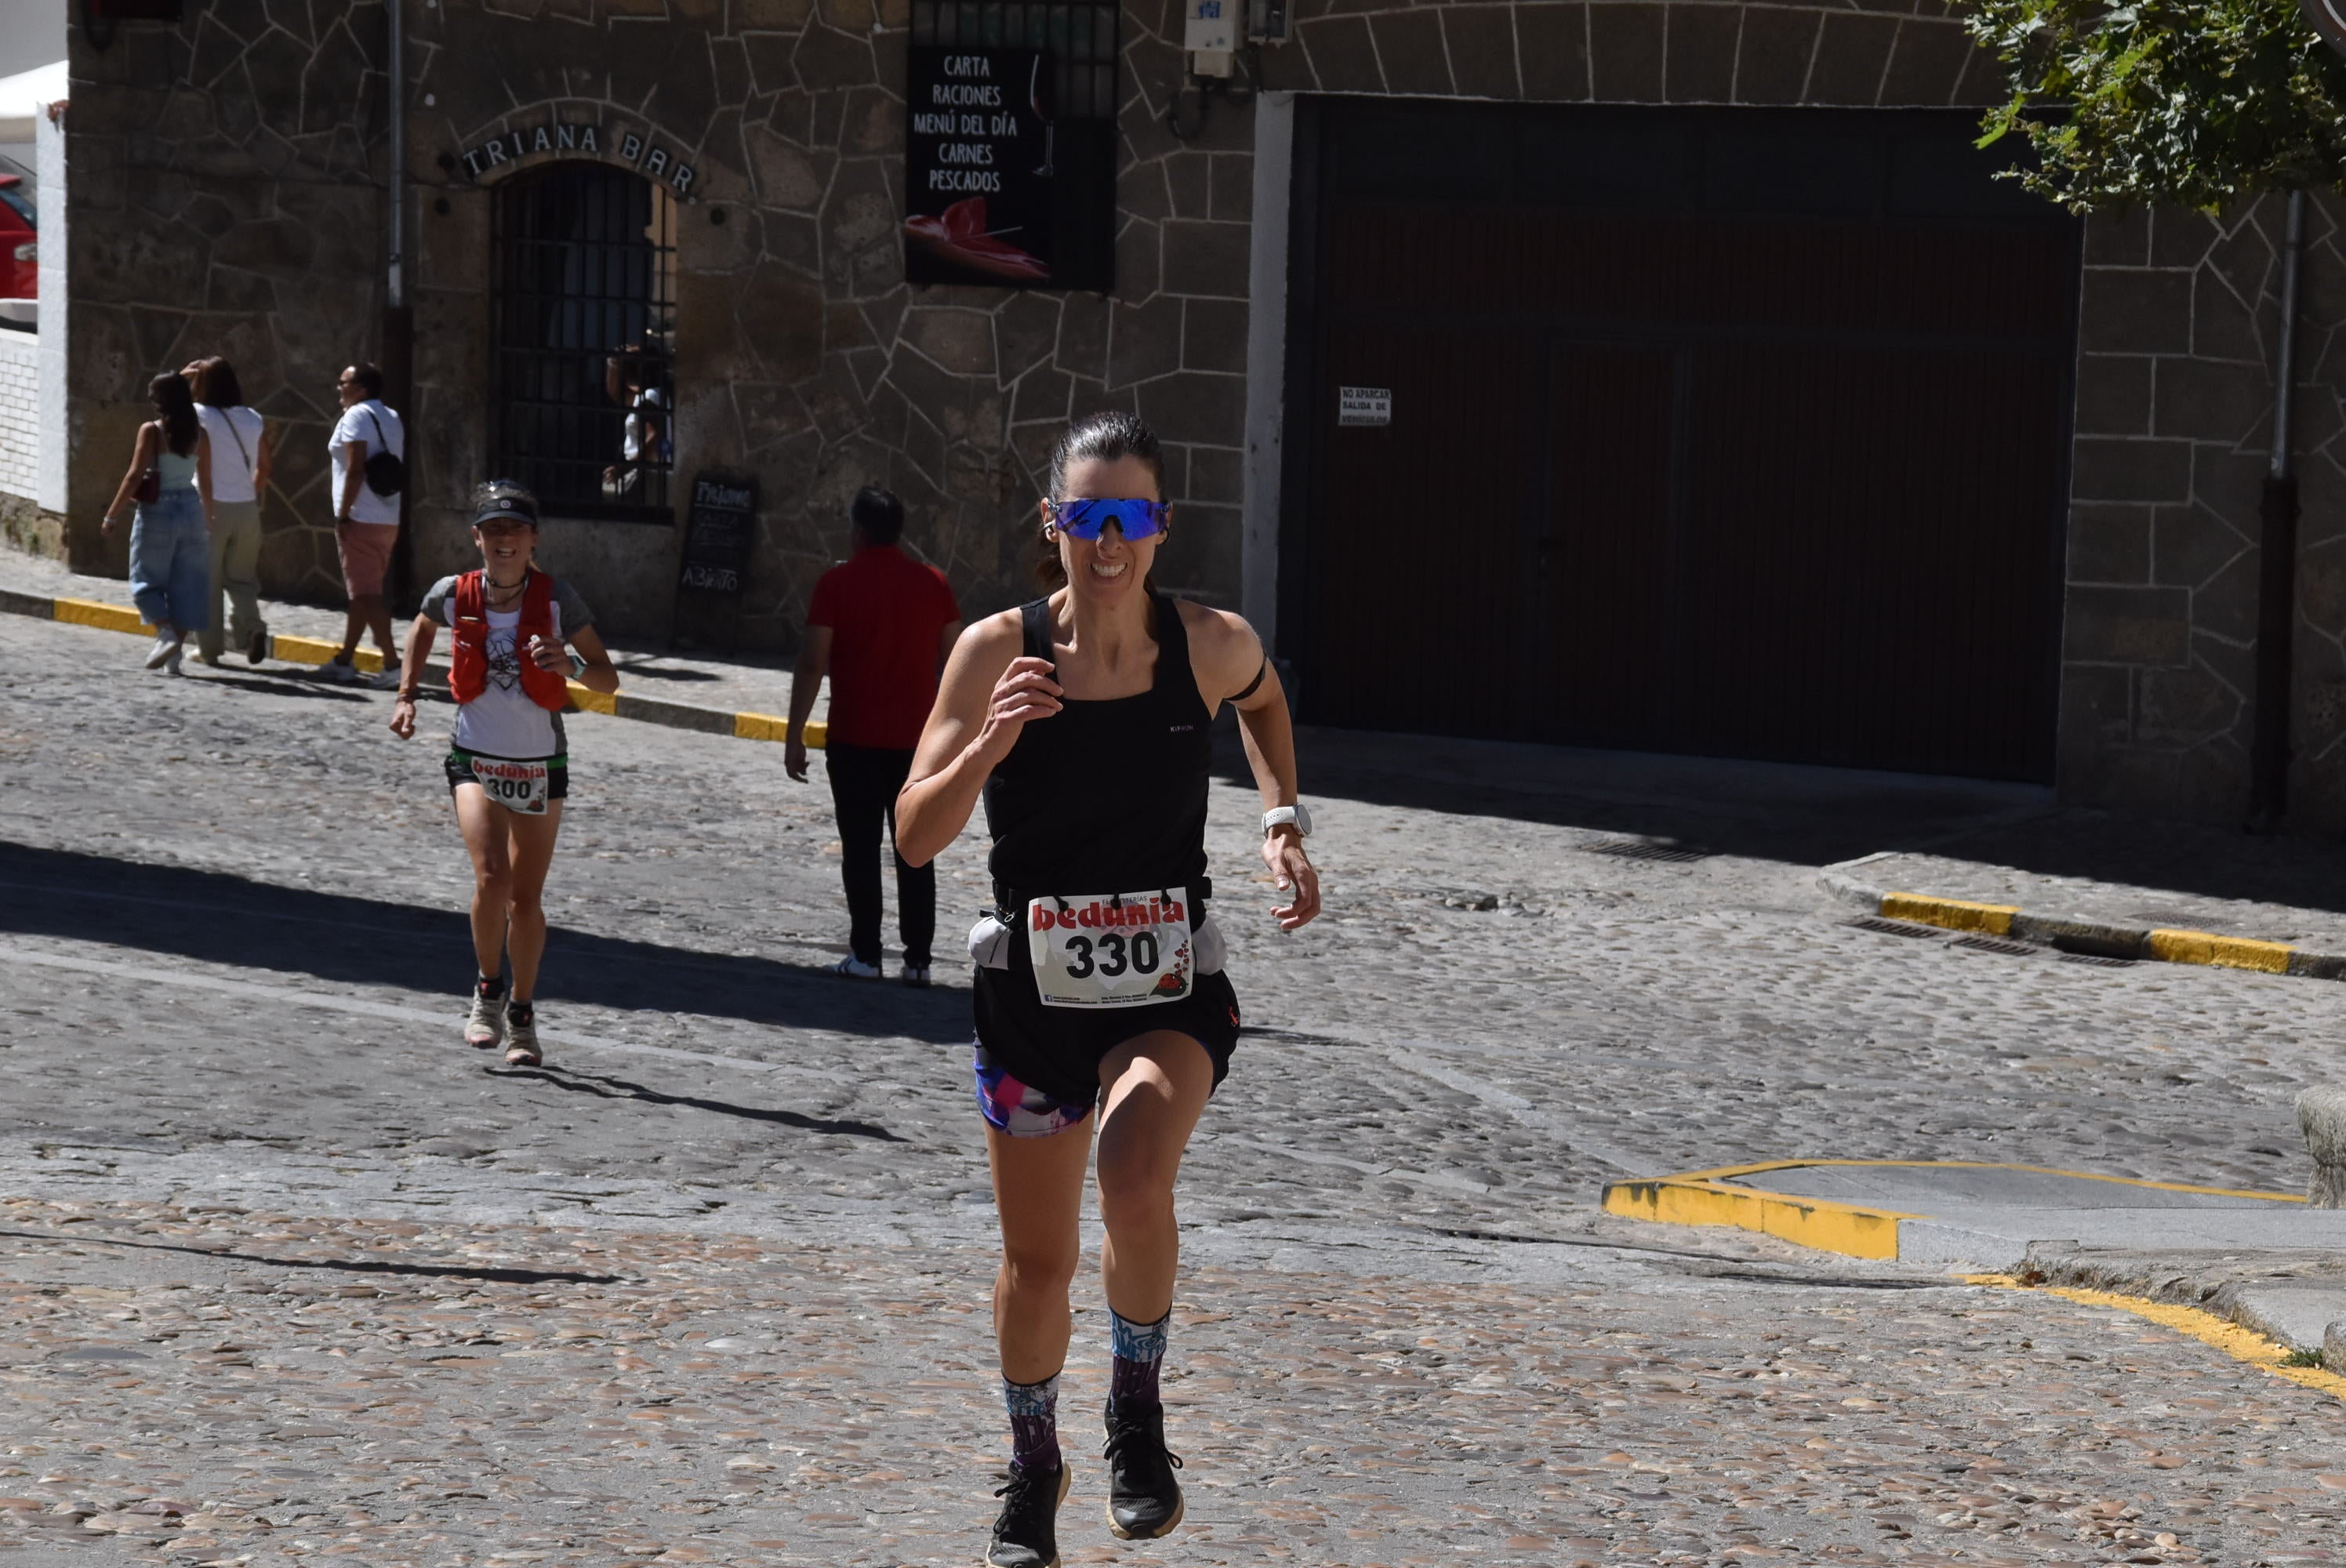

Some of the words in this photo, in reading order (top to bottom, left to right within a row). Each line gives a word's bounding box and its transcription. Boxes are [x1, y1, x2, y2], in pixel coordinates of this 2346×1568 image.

[944, 56, 990, 77] CARTA
[933, 84, 1001, 106] RACIONES
[913, 109, 956, 134] MENÚ
[961, 114, 986, 136] DEL
[992, 111, 1017, 136] DÍA
[463, 125, 597, 176] TRIANA
[621, 134, 692, 193] BAR
[939, 143, 993, 165] CARNES
[929, 169, 1000, 192] PESCADOS
[1343, 389, 1354, 397] NO
[1356, 389, 1390, 400] APARCAR
[1342, 401, 1371, 410] SALIDA
[1376, 401, 1386, 411] DE
[473, 760, 546, 779] bedunia
[487, 779, 532, 799] 300
[1102, 895, 1148, 905] FLSTERÍAS
[1033, 897, 1185, 931] bedunia
[1066, 931, 1160, 978] 330
